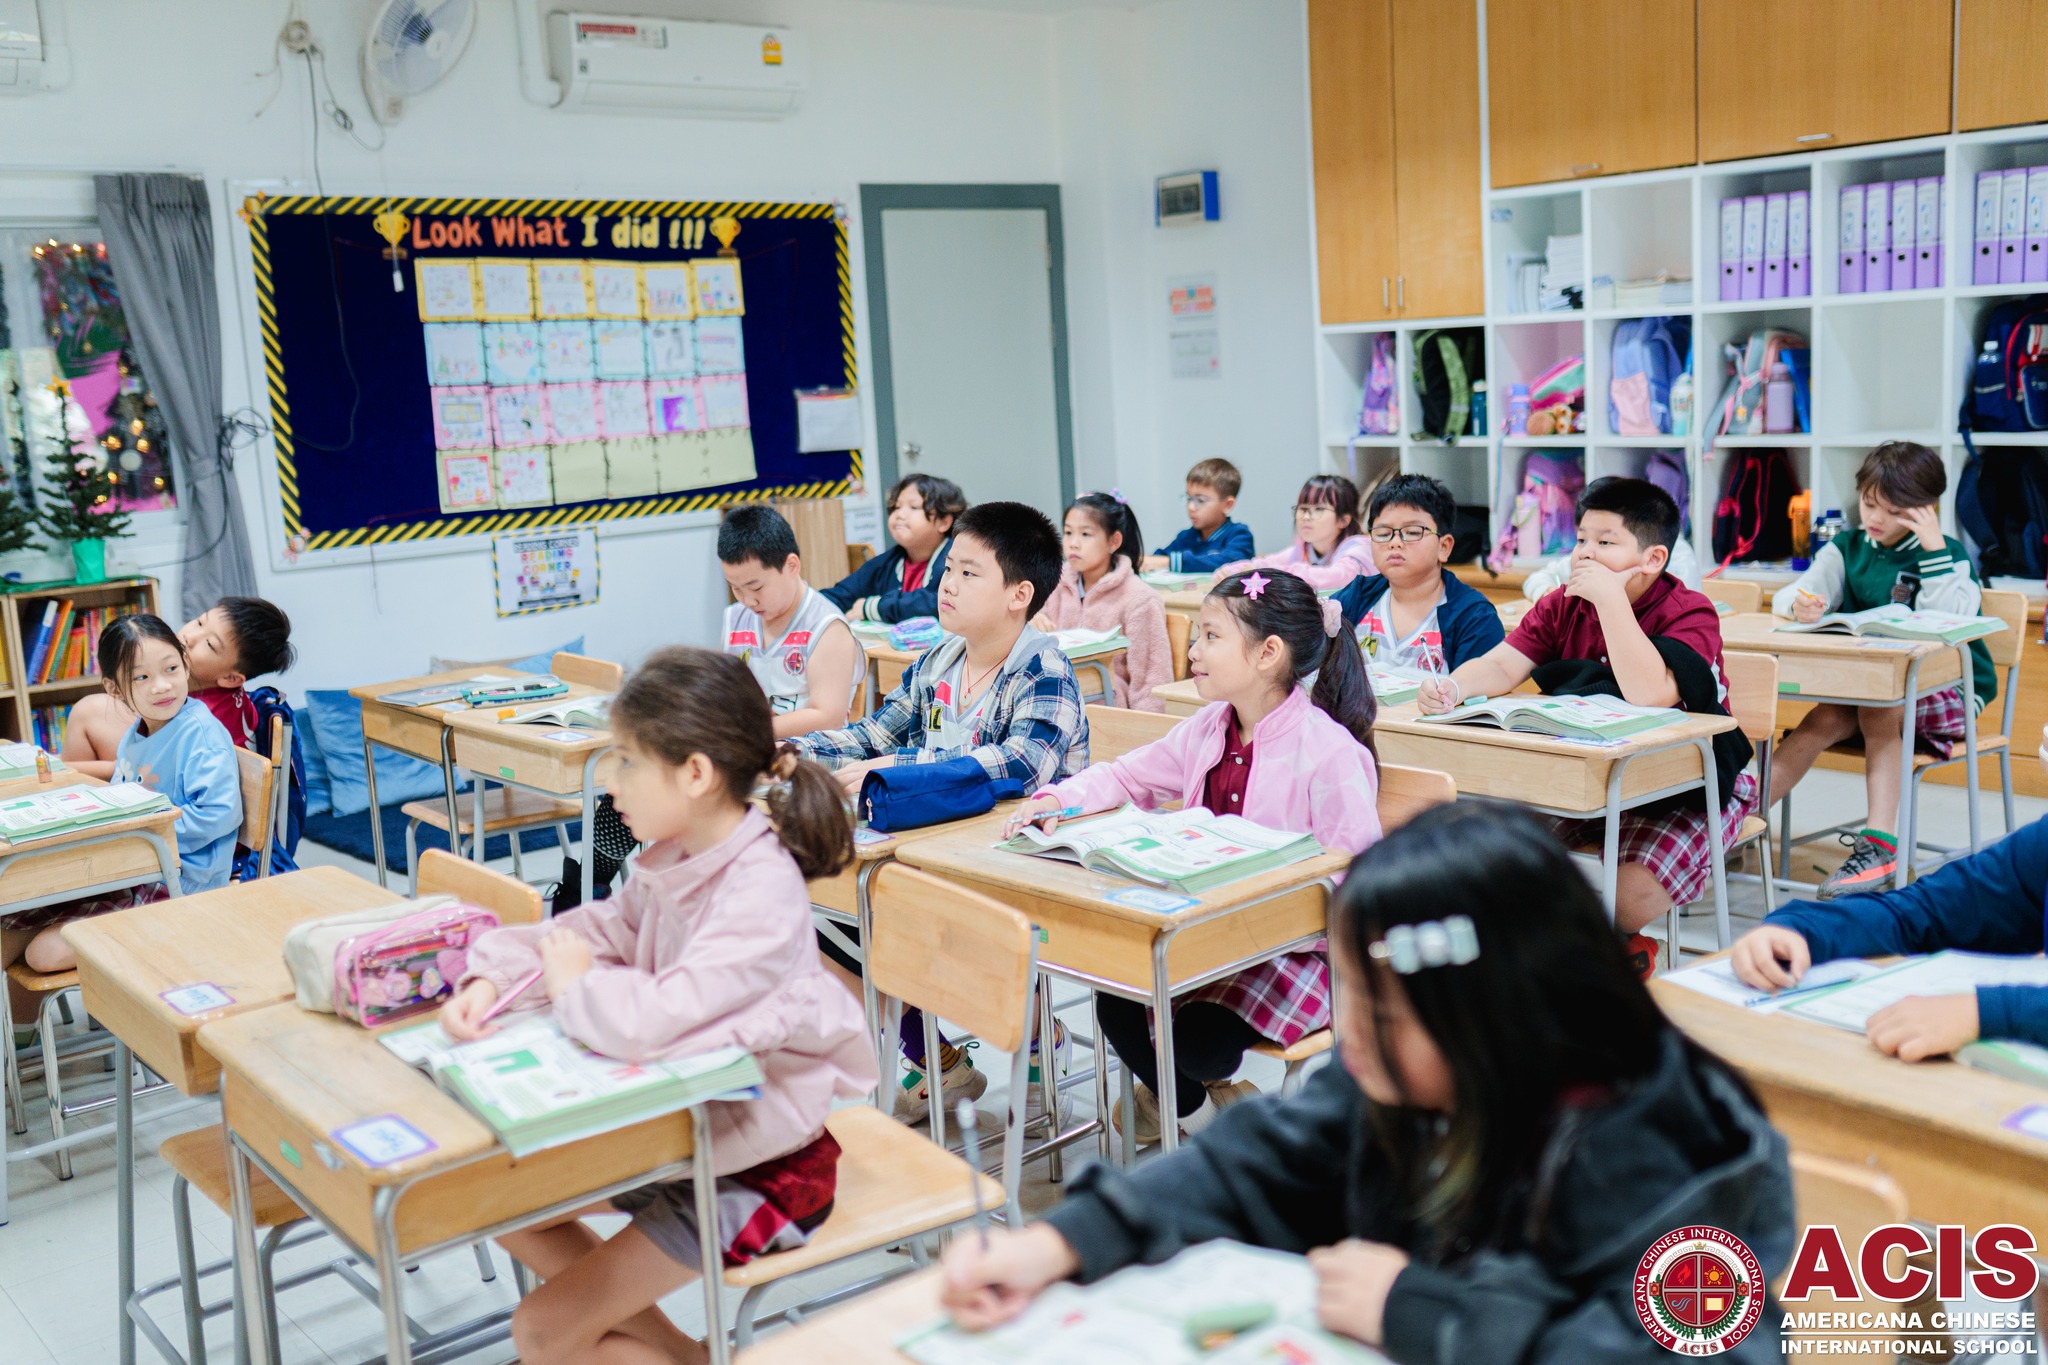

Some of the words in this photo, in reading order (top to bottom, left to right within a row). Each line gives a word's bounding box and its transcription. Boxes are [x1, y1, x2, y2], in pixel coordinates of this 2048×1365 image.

[412, 215, 482, 249] Look
[491, 215, 570, 248] What
[581, 215, 599, 247] I
[611, 215, 660, 248] did
[669, 218, 706, 249] !!!
[521, 547, 573, 563] READING
[523, 561, 571, 576] CORNER
